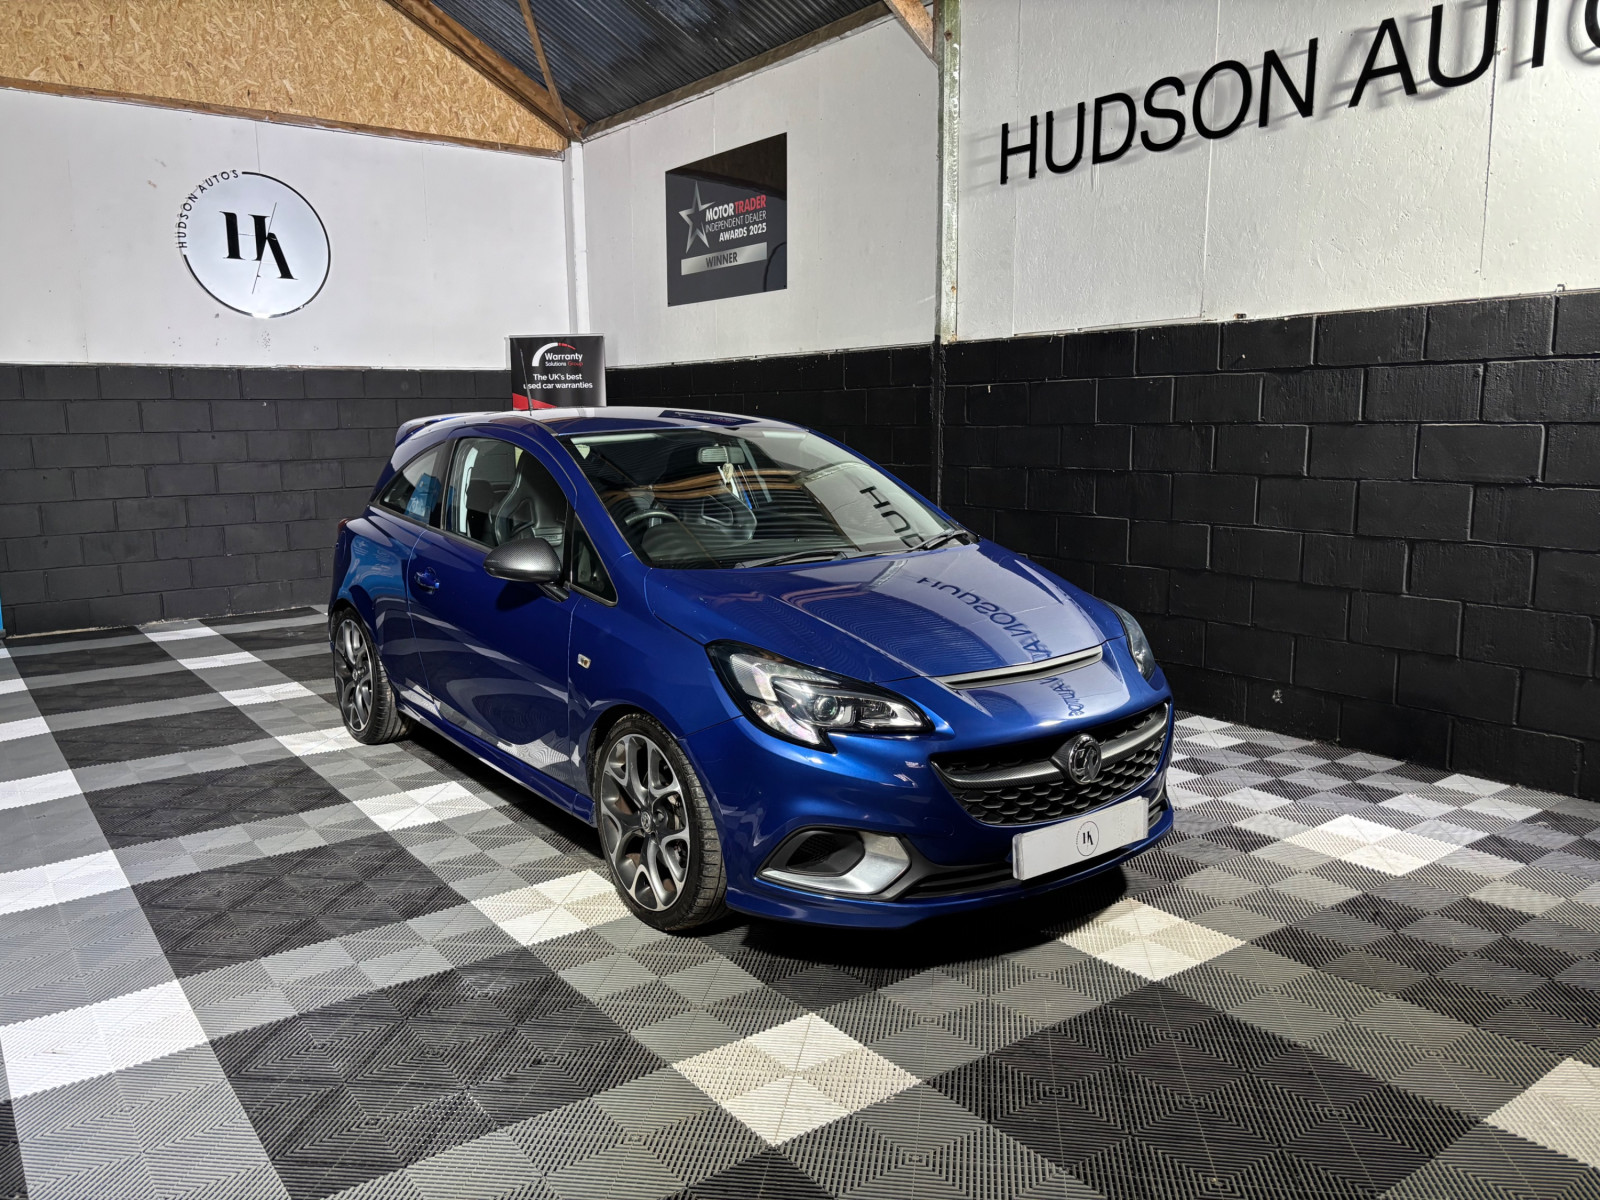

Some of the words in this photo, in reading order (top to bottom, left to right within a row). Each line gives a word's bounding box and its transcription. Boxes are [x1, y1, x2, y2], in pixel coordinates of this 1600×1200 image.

[1000, 37, 1318, 185] HUDSON
[1348, 0, 1600, 108] AUT
[176, 193, 199, 249] HUDSON
[198, 169, 240, 194] AUTOS
[705, 215, 744, 233] INDEPENDENT
[745, 210, 767, 225] DEALER
[719, 226, 748, 242] AWARDS
[749, 222, 767, 236] 2025
[705, 251, 738, 268] WINNER
[544, 352, 583, 362] Warranty
[533, 373, 548, 381] The
[555, 381, 593, 389] warranties
